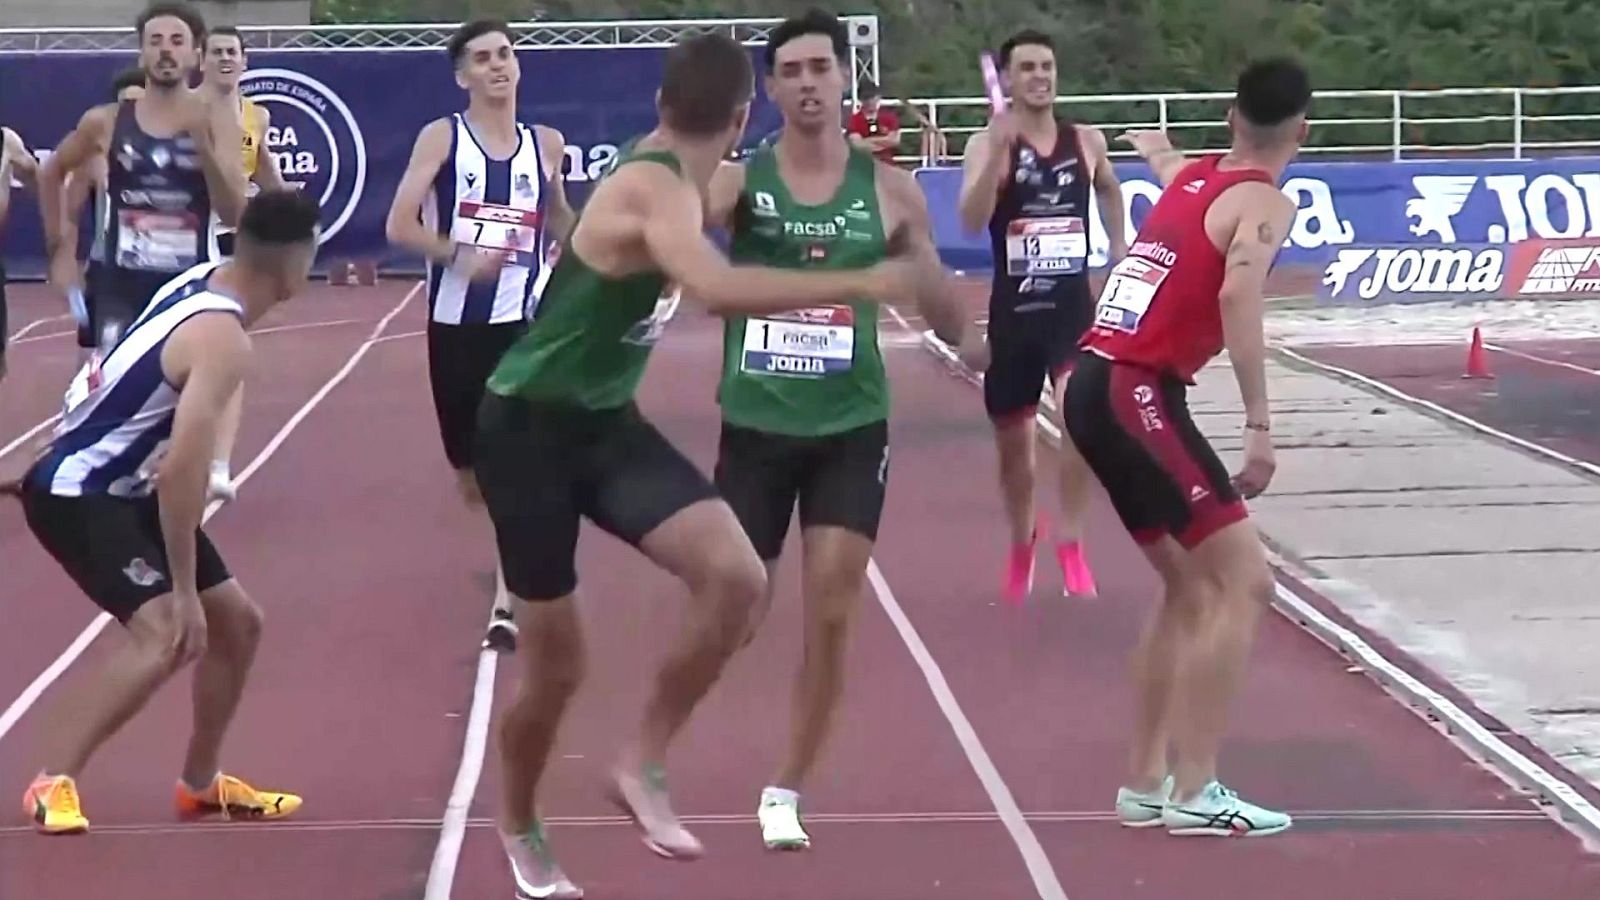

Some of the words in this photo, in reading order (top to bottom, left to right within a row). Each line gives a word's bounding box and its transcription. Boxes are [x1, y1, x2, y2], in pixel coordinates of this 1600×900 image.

[473, 222, 484, 244] 7
[1023, 236, 1041, 256] 13
[1358, 249, 1503, 299] Joma
[761, 323, 770, 350] 1
